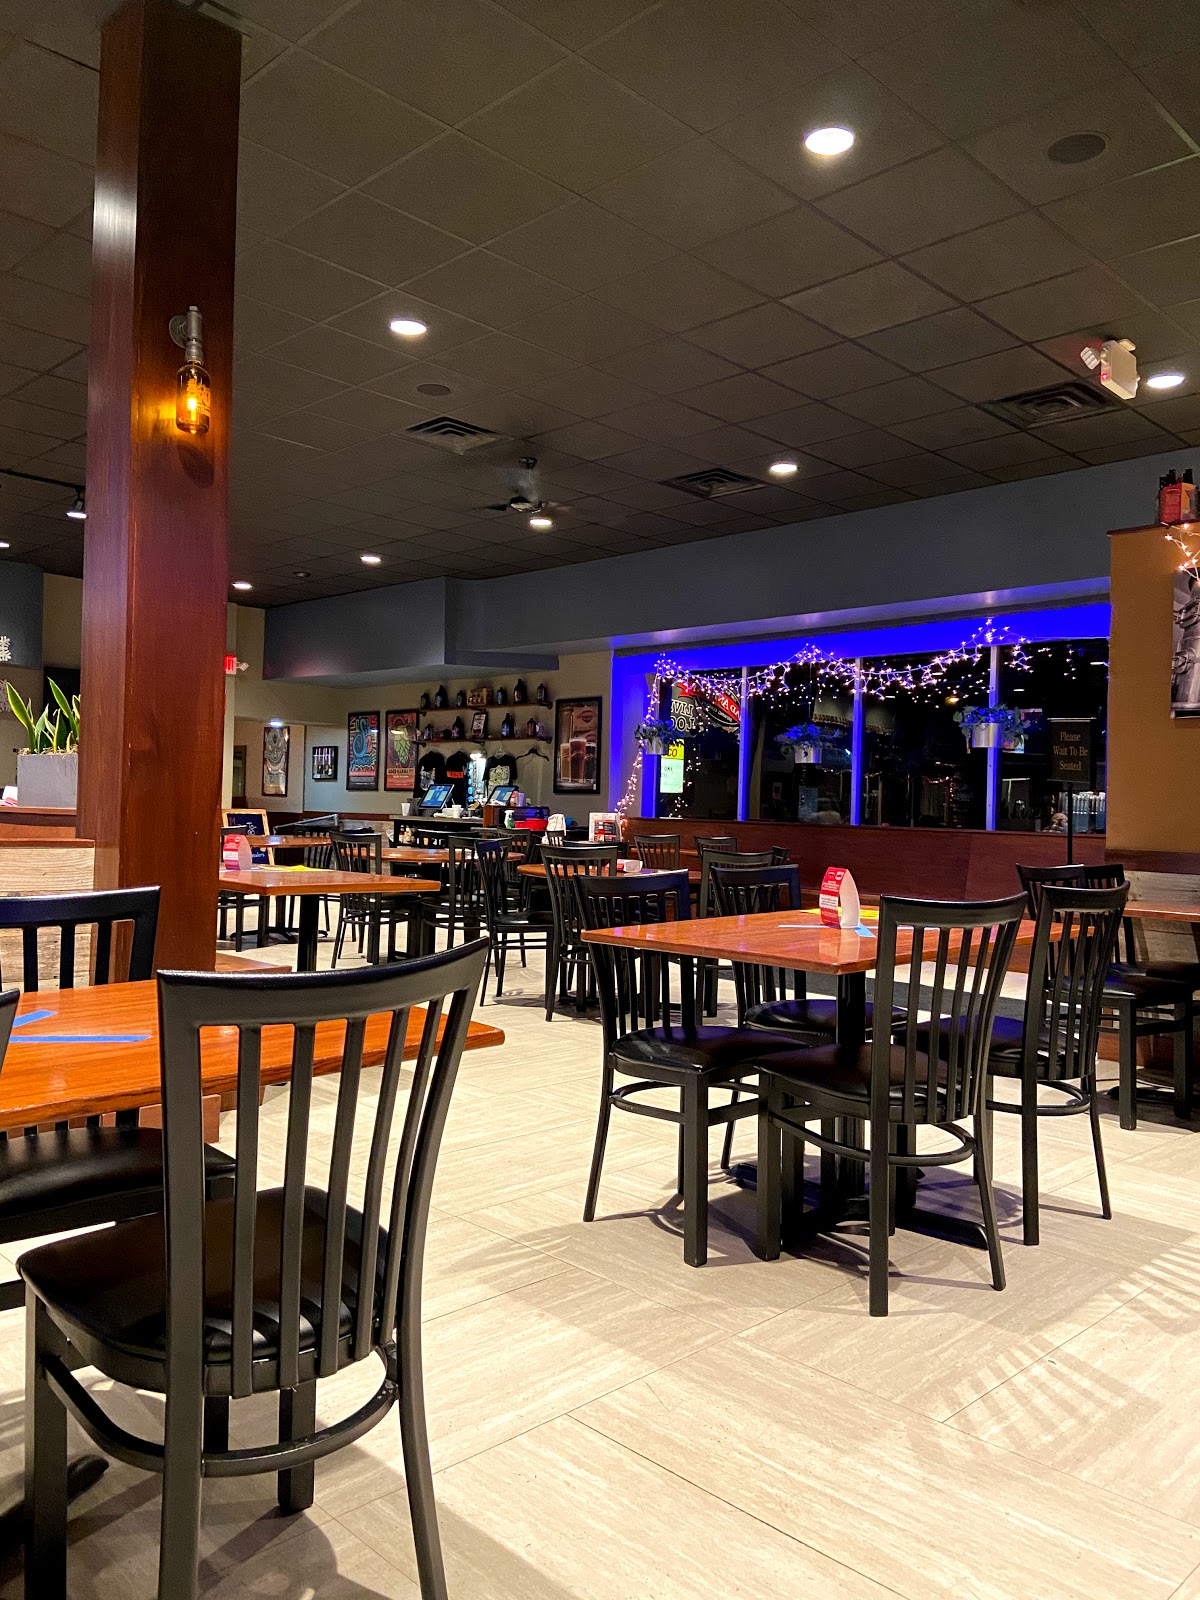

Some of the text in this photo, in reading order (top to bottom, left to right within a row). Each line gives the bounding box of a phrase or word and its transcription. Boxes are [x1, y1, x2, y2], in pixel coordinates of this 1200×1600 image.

[1060, 731, 1080, 741] Please
[1053, 745, 1089, 756] Wait To Be
[1060, 760, 1081, 771] Seated
